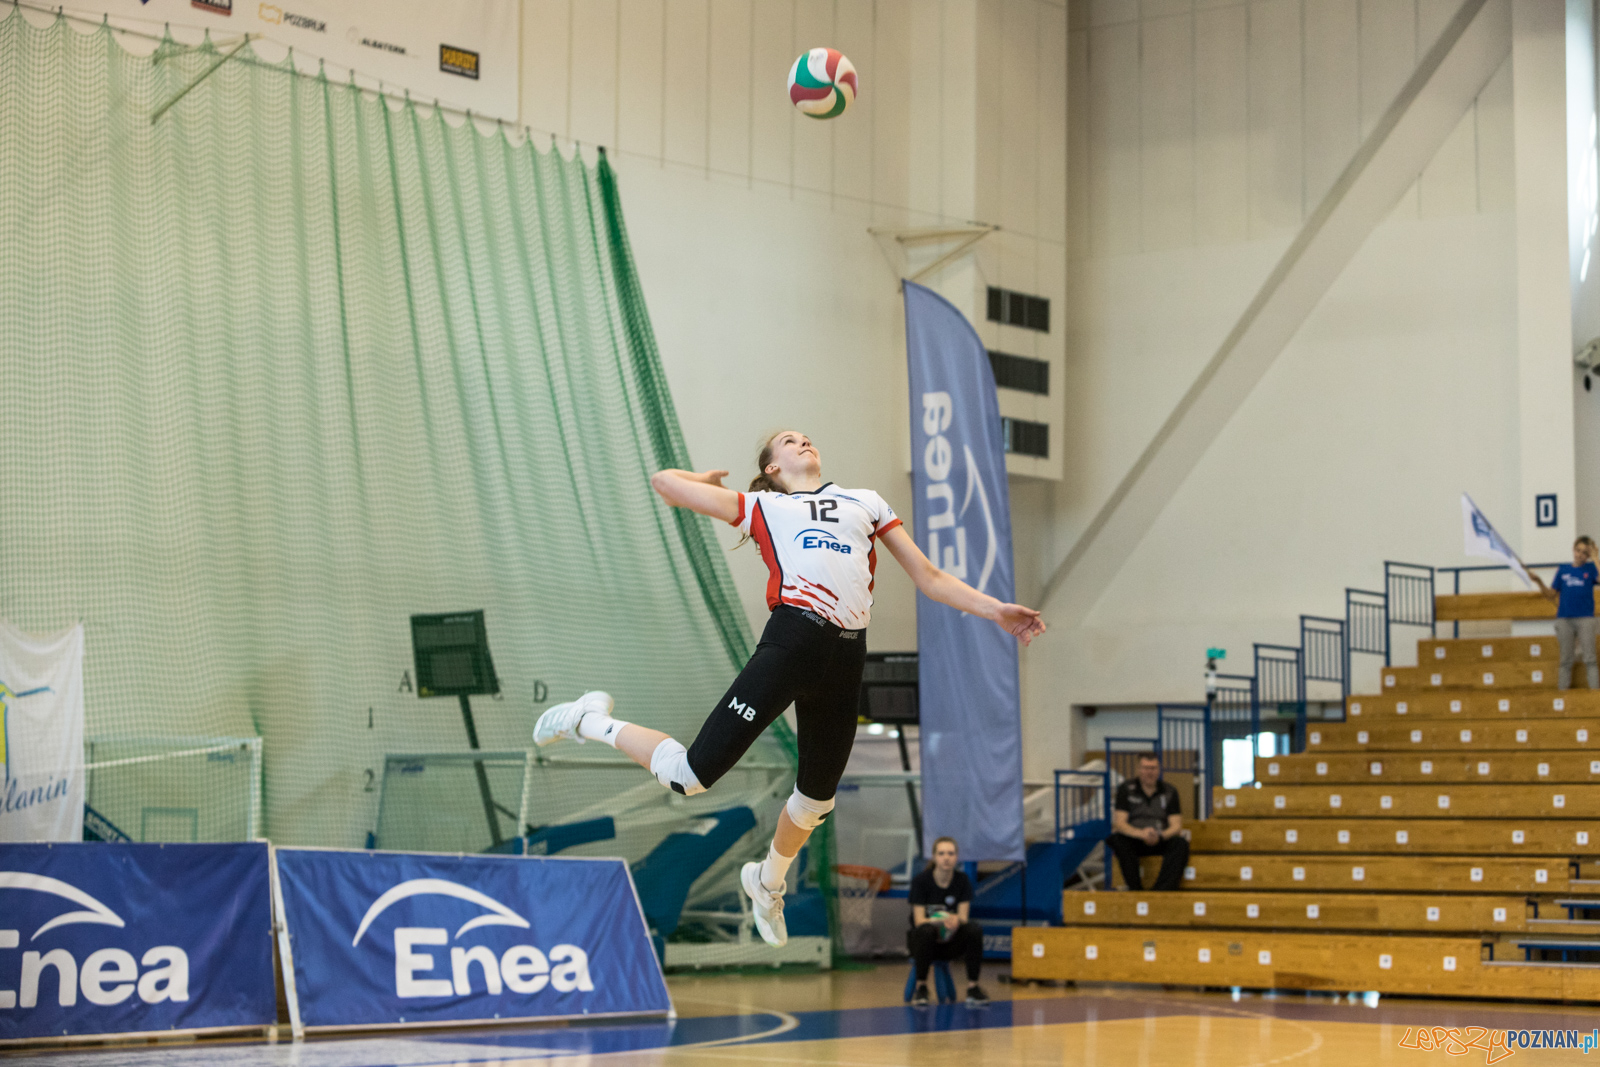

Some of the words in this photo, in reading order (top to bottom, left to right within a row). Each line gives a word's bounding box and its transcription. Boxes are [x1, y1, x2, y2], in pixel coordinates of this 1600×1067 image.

[803, 499, 839, 523] 12
[802, 536, 851, 555] Enea
[801, 610, 827, 627] NIKE
[839, 630, 859, 640] NIKE
[398, 670, 413, 693] A
[533, 679, 548, 703] D
[727, 696, 756, 722] MB
[363, 768, 376, 792] 2
[0, 929, 190, 1008] nea
[393, 926, 595, 998] Enea
